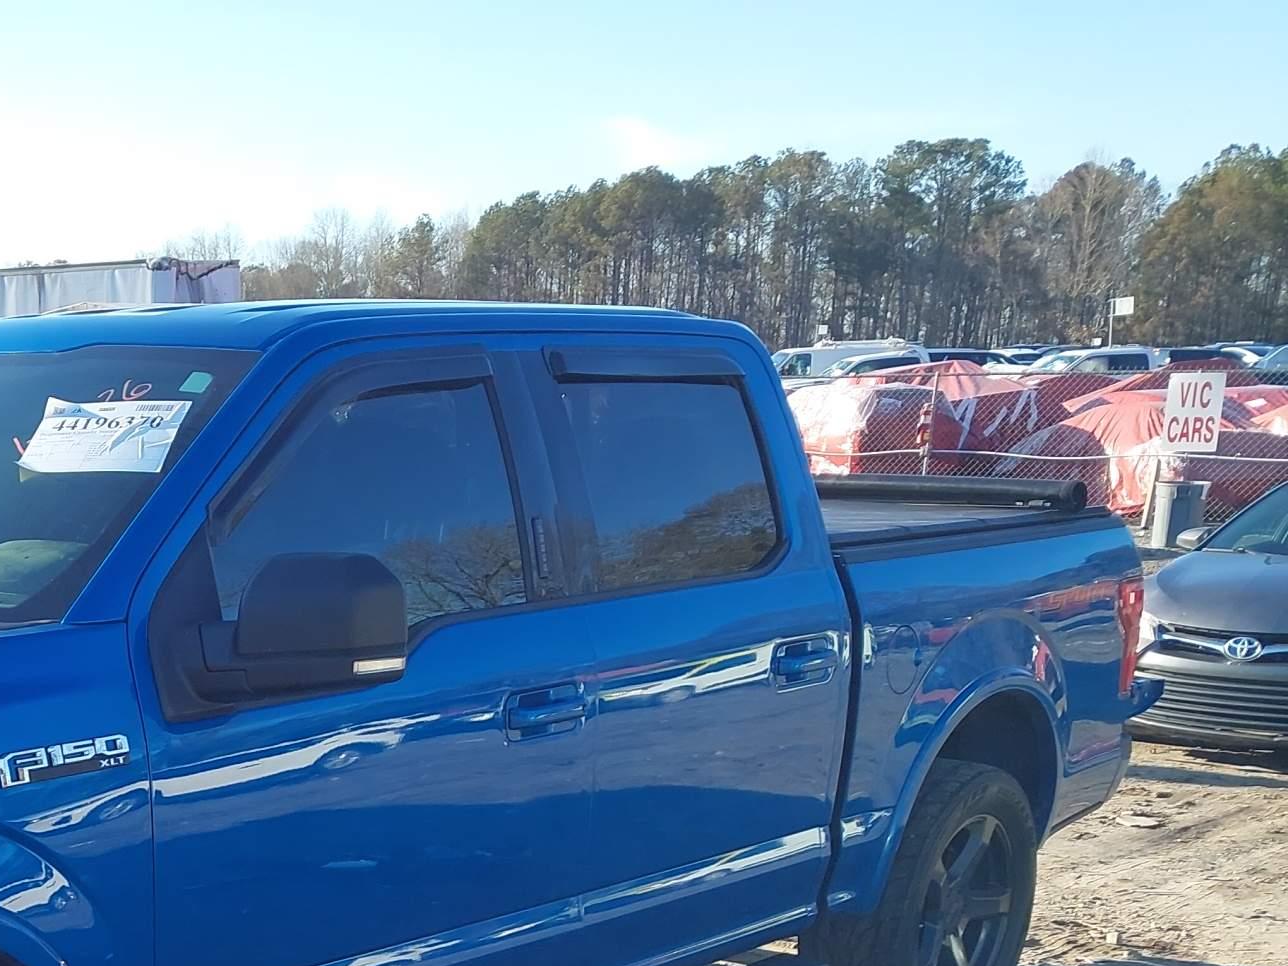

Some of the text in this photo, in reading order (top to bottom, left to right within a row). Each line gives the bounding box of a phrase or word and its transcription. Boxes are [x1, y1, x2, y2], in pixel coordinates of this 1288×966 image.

[1180, 381, 1213, 409] VIC
[52, 415, 164, 432] 44196370
[1167, 416, 1216, 444] CARS
[99, 755, 127, 768] XLT
